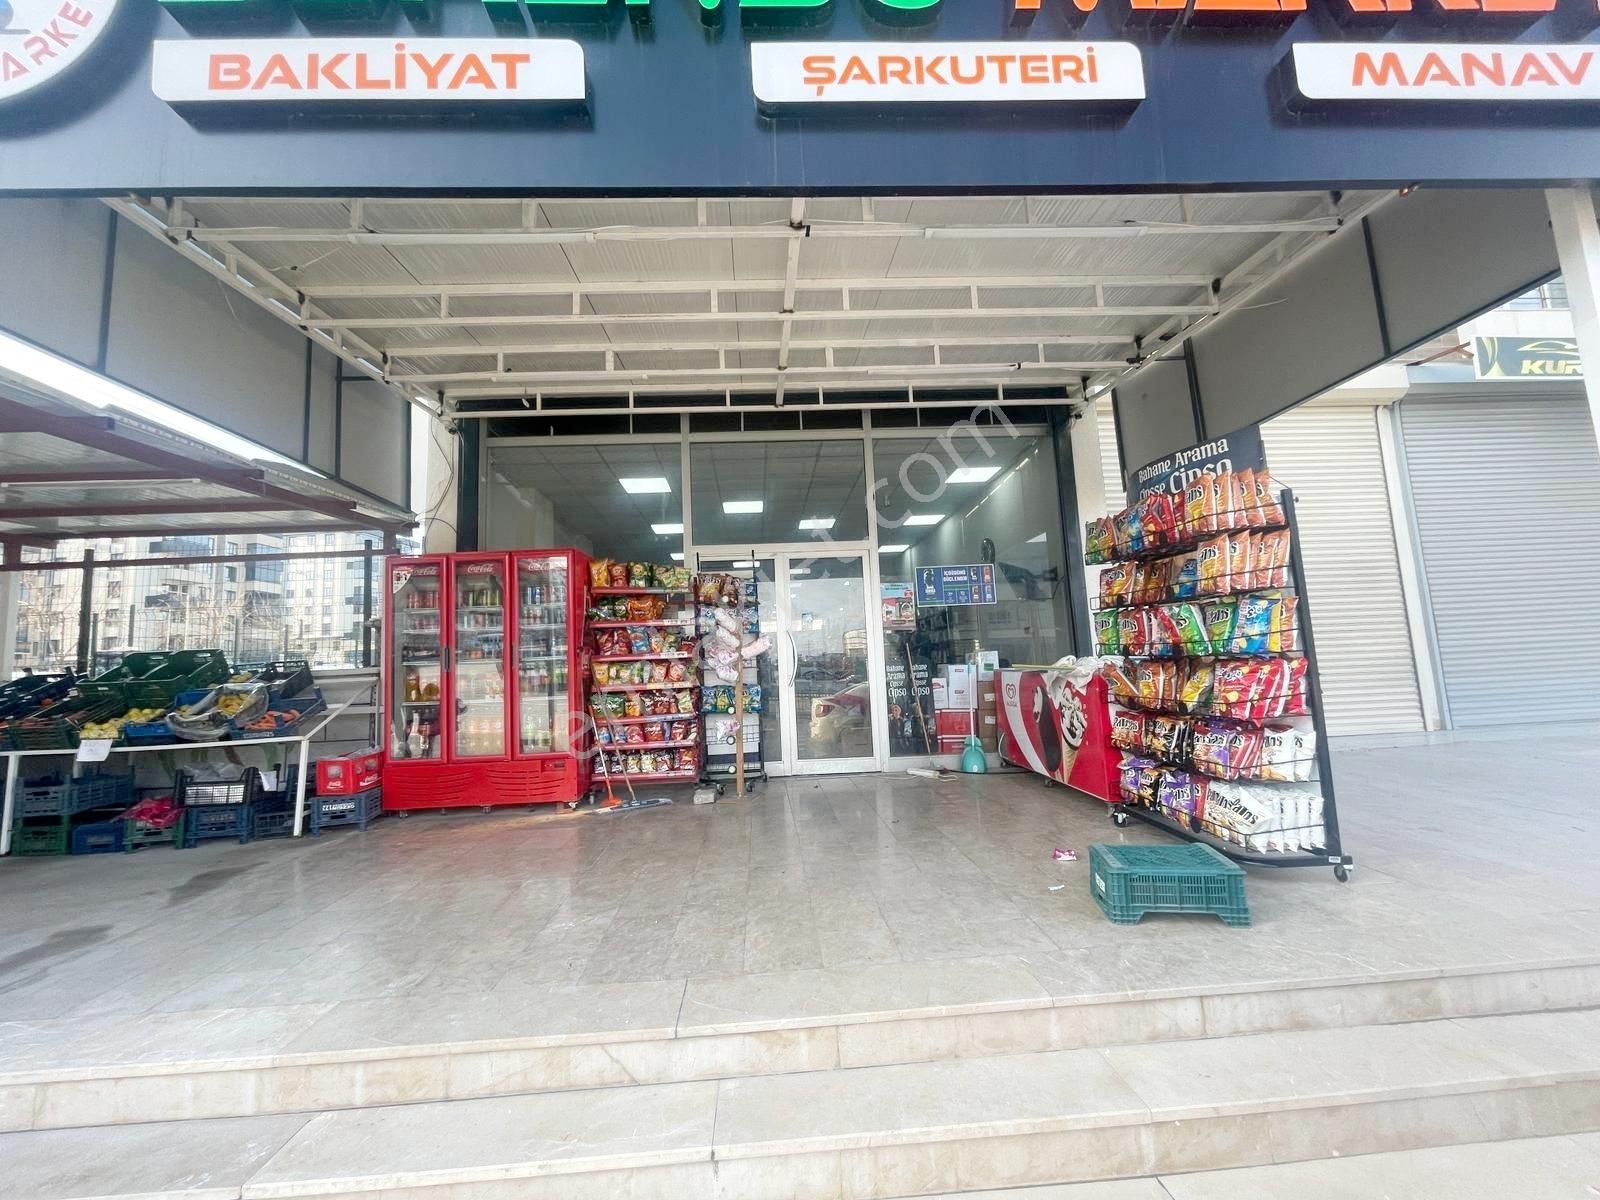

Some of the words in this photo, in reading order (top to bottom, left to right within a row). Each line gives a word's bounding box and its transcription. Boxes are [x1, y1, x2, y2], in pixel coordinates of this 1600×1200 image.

[207, 42, 531, 91] BAKLİYAT
[802, 46, 1098, 97] ŞARKUTERİ
[1351, 51, 1595, 88] MANAV
[1138, 459, 1171, 484] Bahane
[1174, 438, 1230, 467] Arama
[467, 563, 494, 574] Coca-Cola
